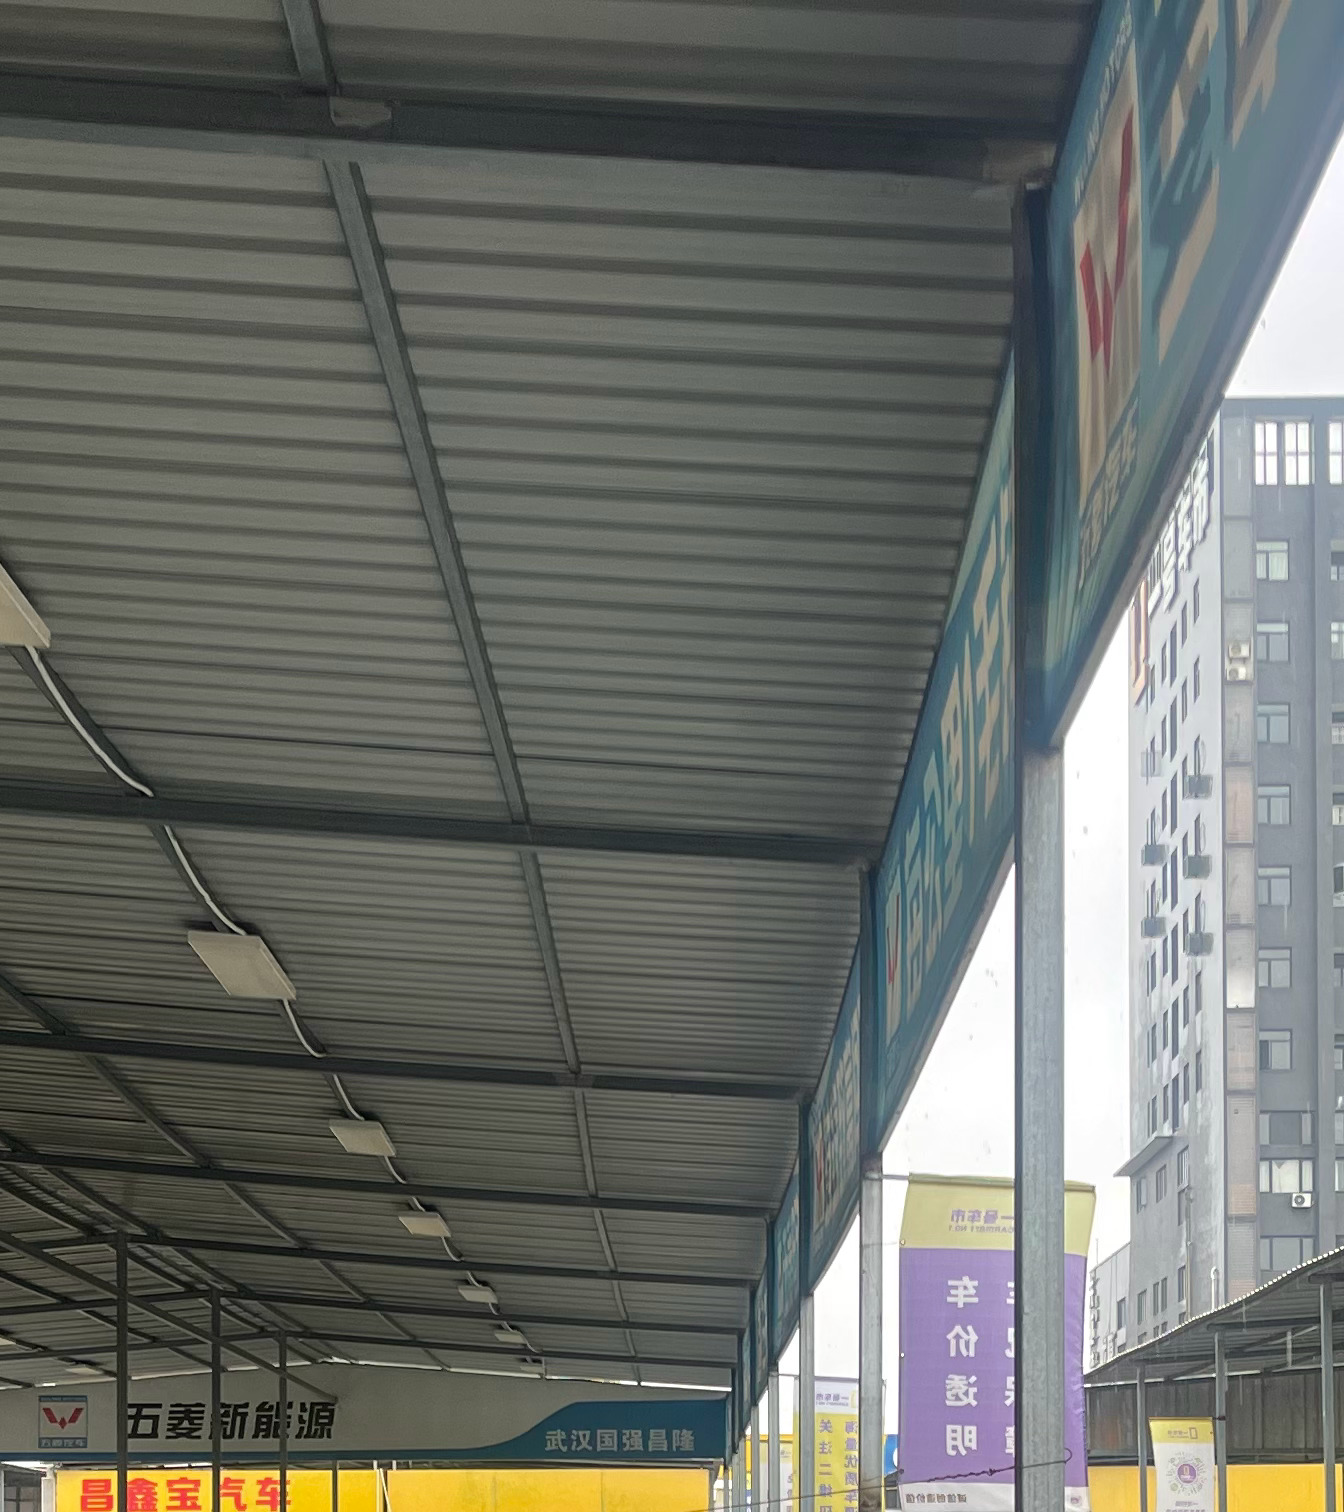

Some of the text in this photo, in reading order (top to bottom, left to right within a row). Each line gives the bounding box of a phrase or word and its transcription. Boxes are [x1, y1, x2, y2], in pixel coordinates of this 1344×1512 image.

[127, 1402, 336, 1440] 五菱新能源
[545, 1429, 695, 1452] 武汉国强昌隆
[80, 1476, 291, 1512] 昌鑫宝汽车
